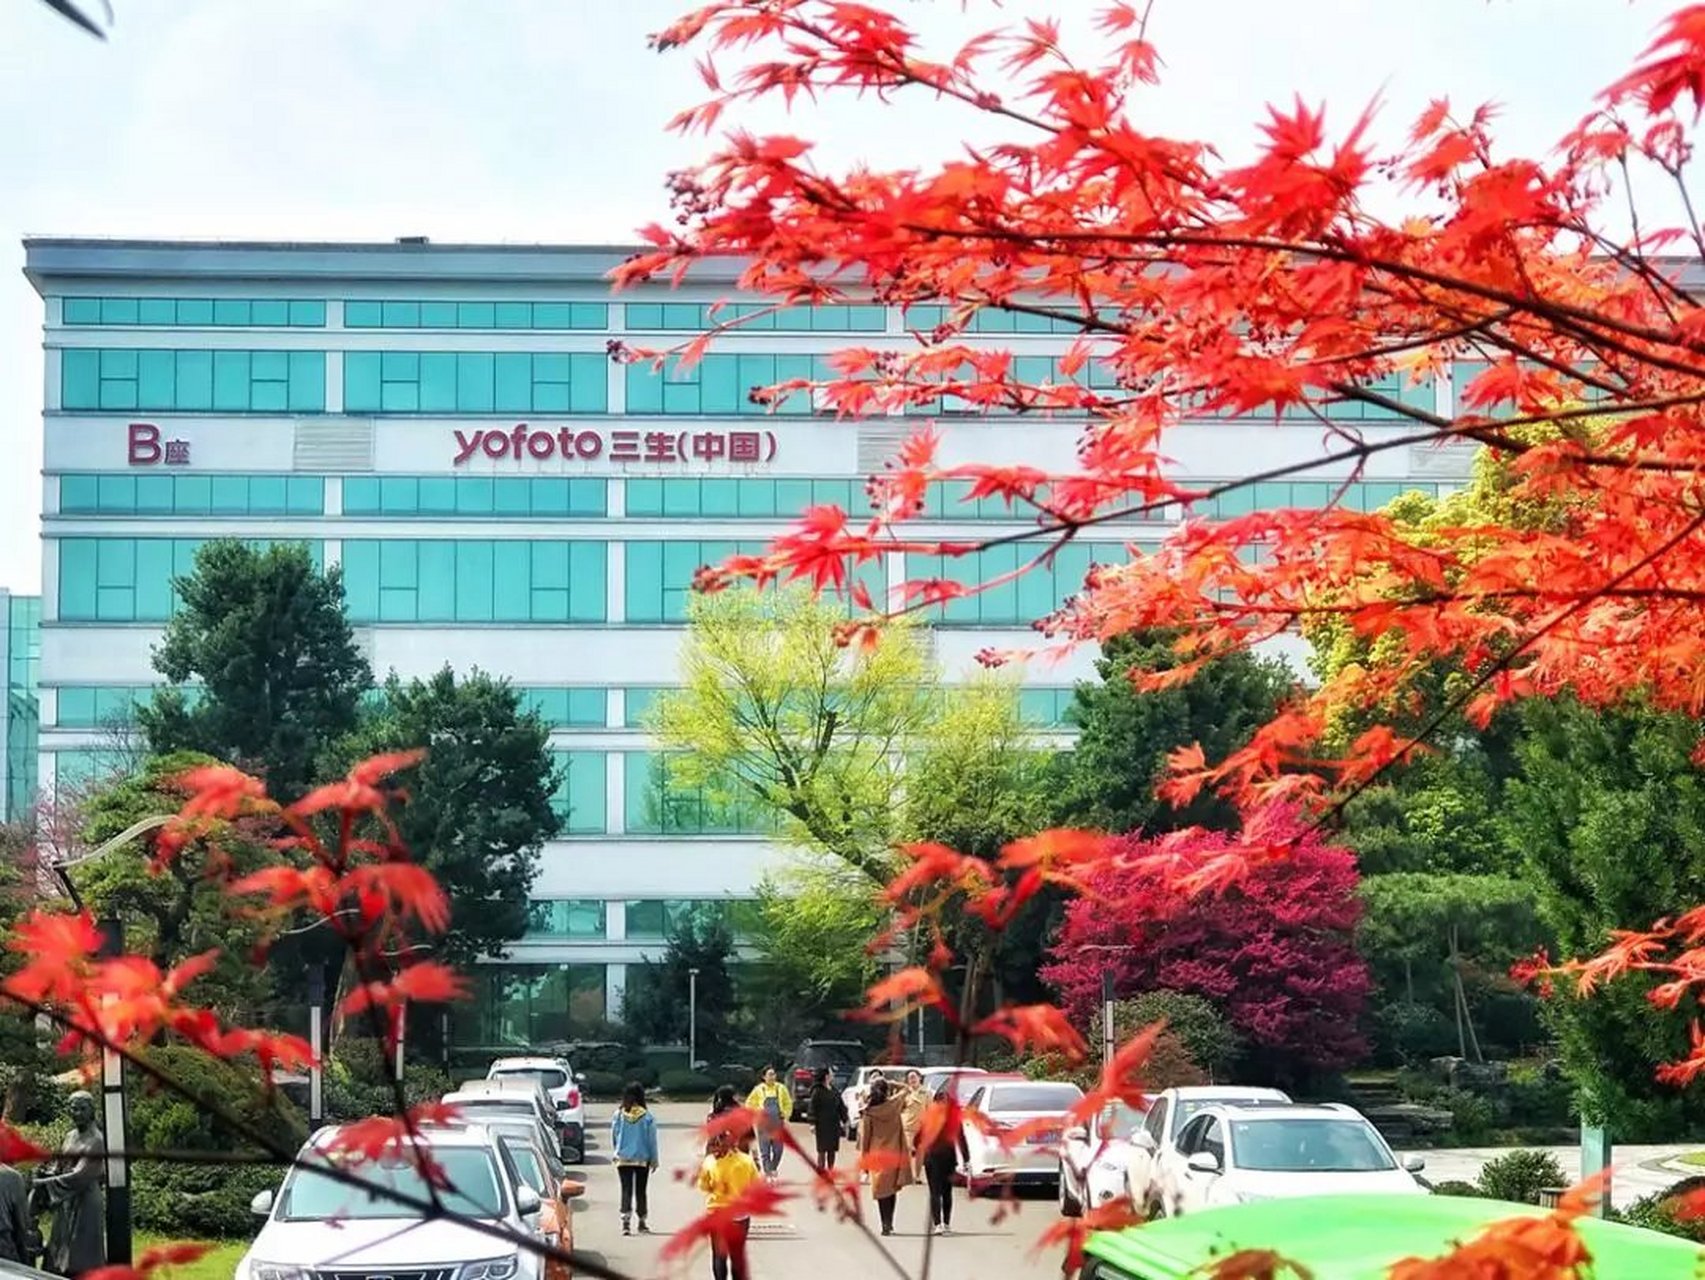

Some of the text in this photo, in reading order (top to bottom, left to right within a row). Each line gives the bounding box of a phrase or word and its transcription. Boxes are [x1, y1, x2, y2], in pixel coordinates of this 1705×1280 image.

[128, 424, 190, 466] B座
[453, 424, 777, 467] yofoto 三生(中国)
